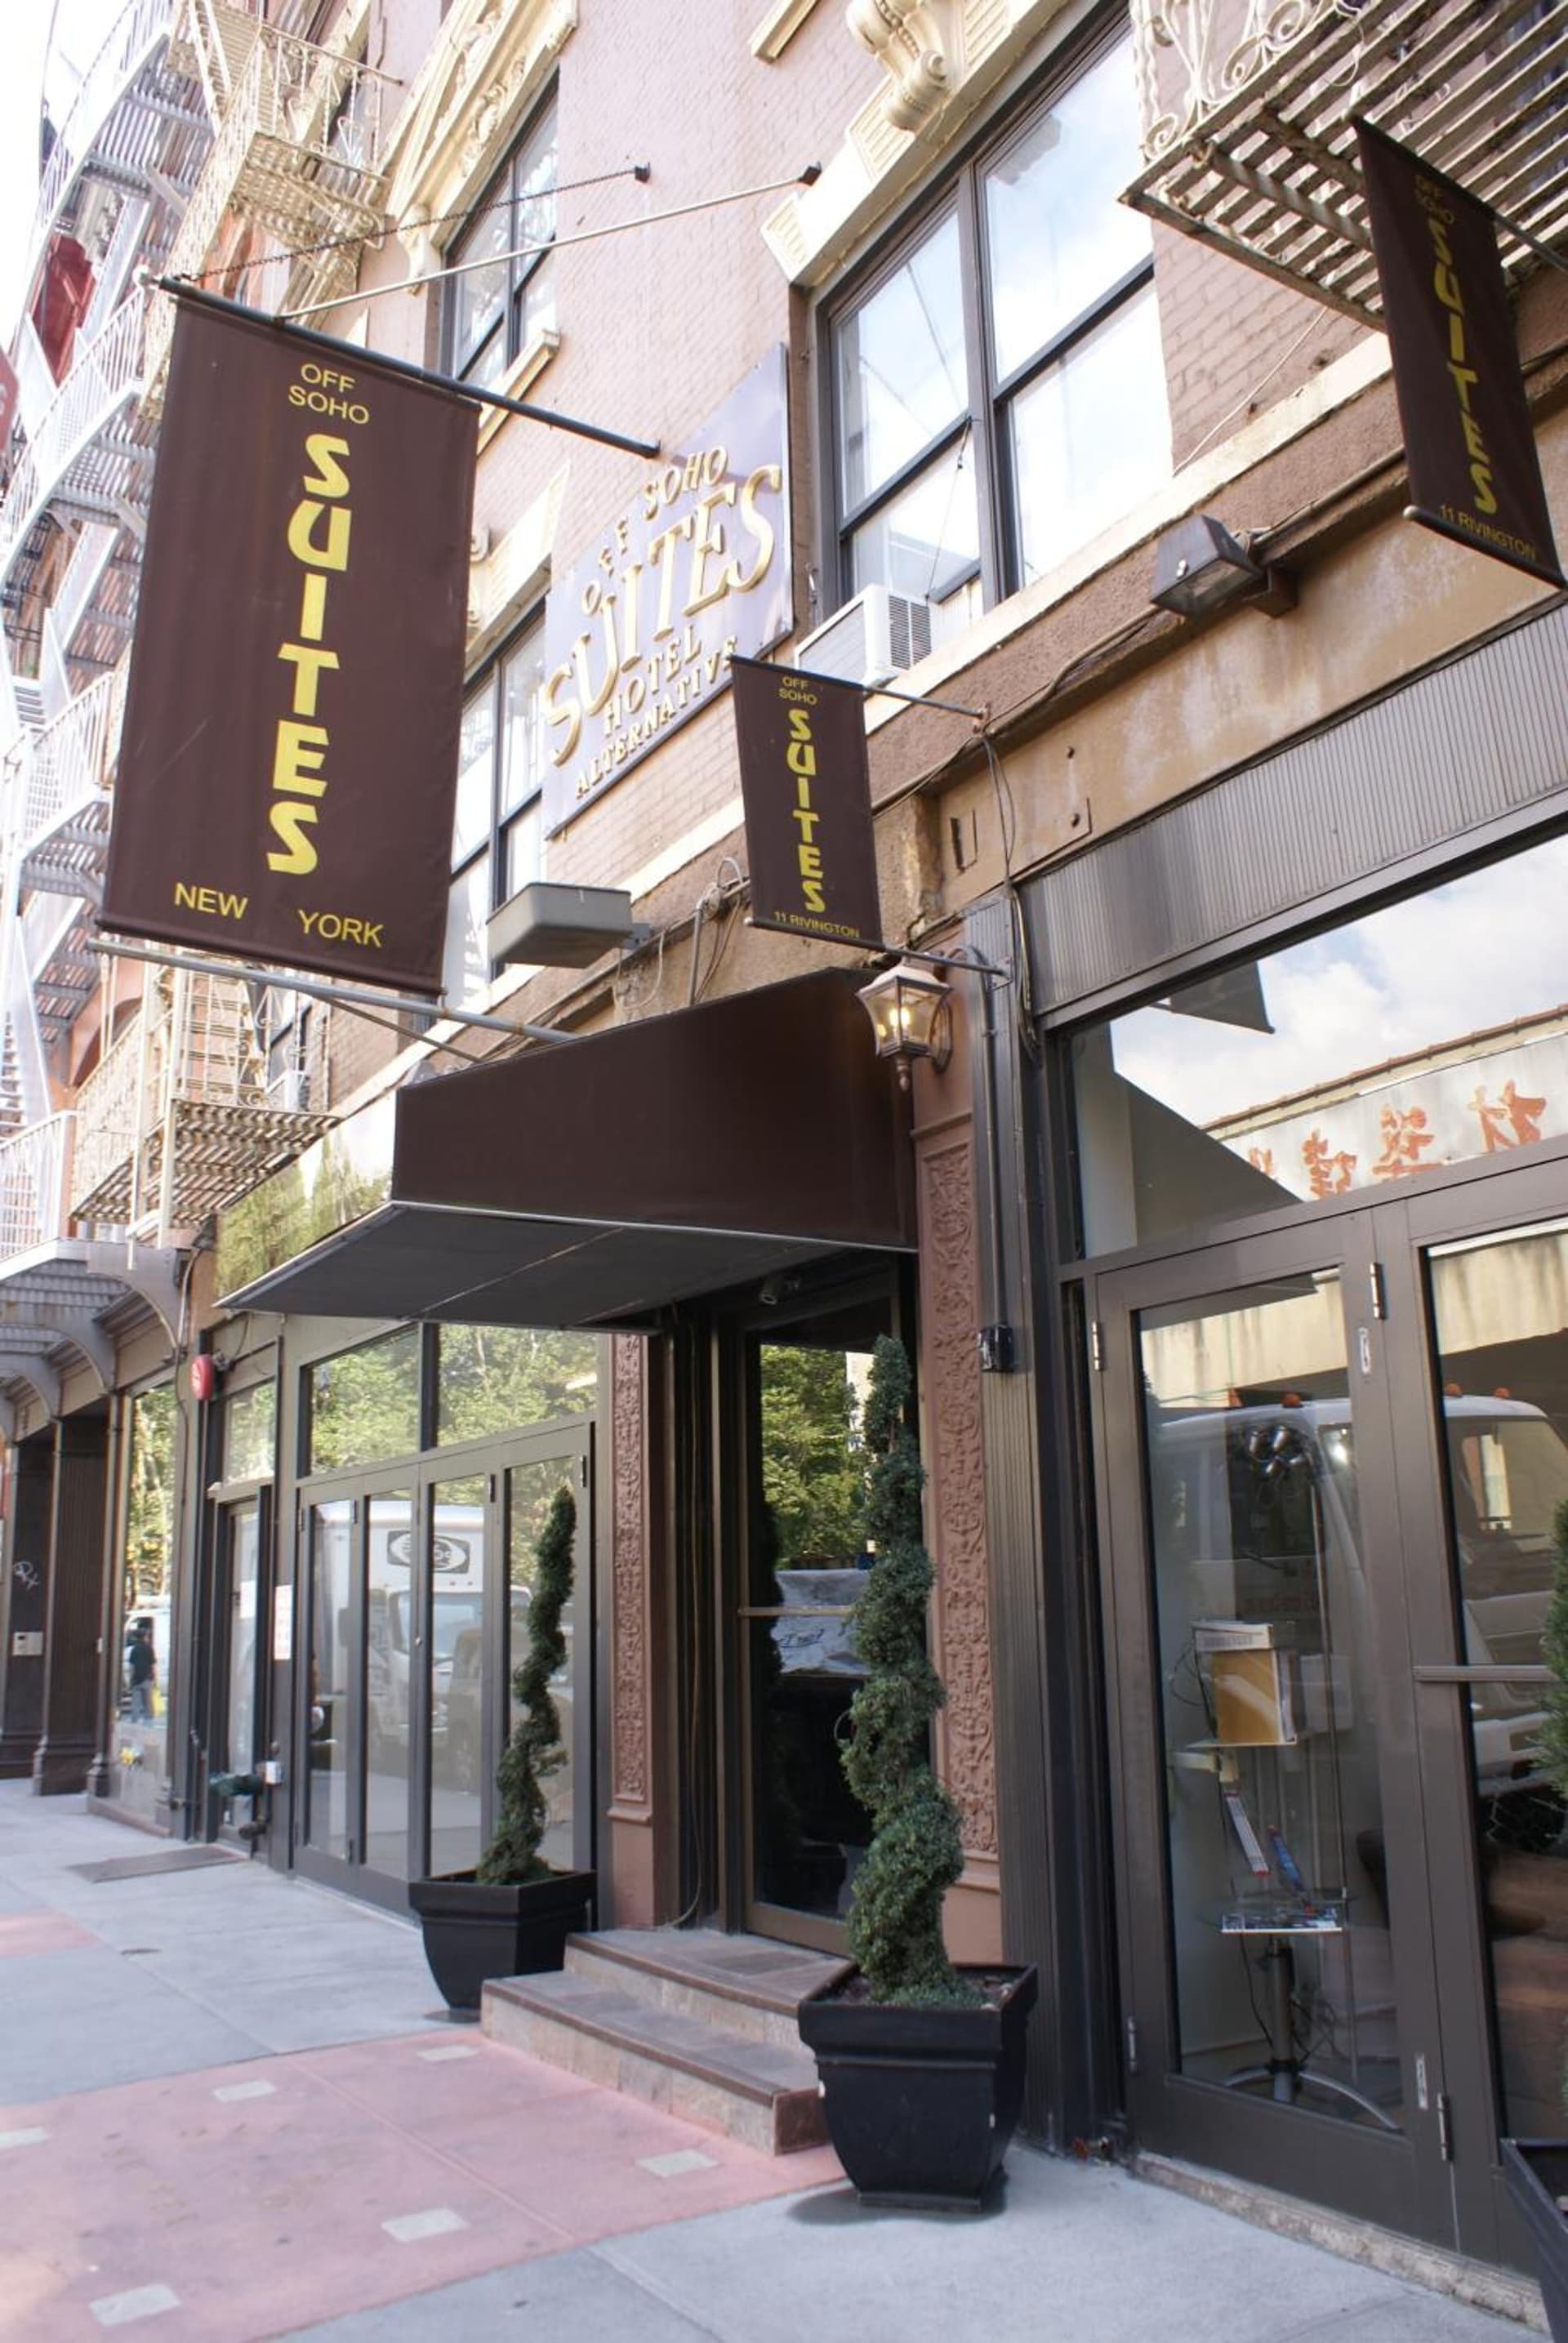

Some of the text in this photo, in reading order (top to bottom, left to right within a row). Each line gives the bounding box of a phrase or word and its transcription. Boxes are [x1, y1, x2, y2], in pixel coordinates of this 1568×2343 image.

[287, 385, 370, 425] SOHO
[300, 363, 356, 393] OFF
[1428, 217, 1498, 514] SUITES
[581, 445, 728, 615] OFF SOHO
[1439, 504, 1537, 561] 11 RIVINGTON
[267, 433, 351, 877] SUITES
[539, 463, 782, 768] SUITES
[576, 634, 737, 800] ALTERNATIVE
[604, 623, 702, 738] HOTEL
[777, 687, 818, 706] SOHO
[782, 675, 809, 691] OFF
[786, 707, 826, 913] SUITES
[174, 881, 385, 948] NEW YORK
[773, 911, 861, 938] 11 RIVINGTON
